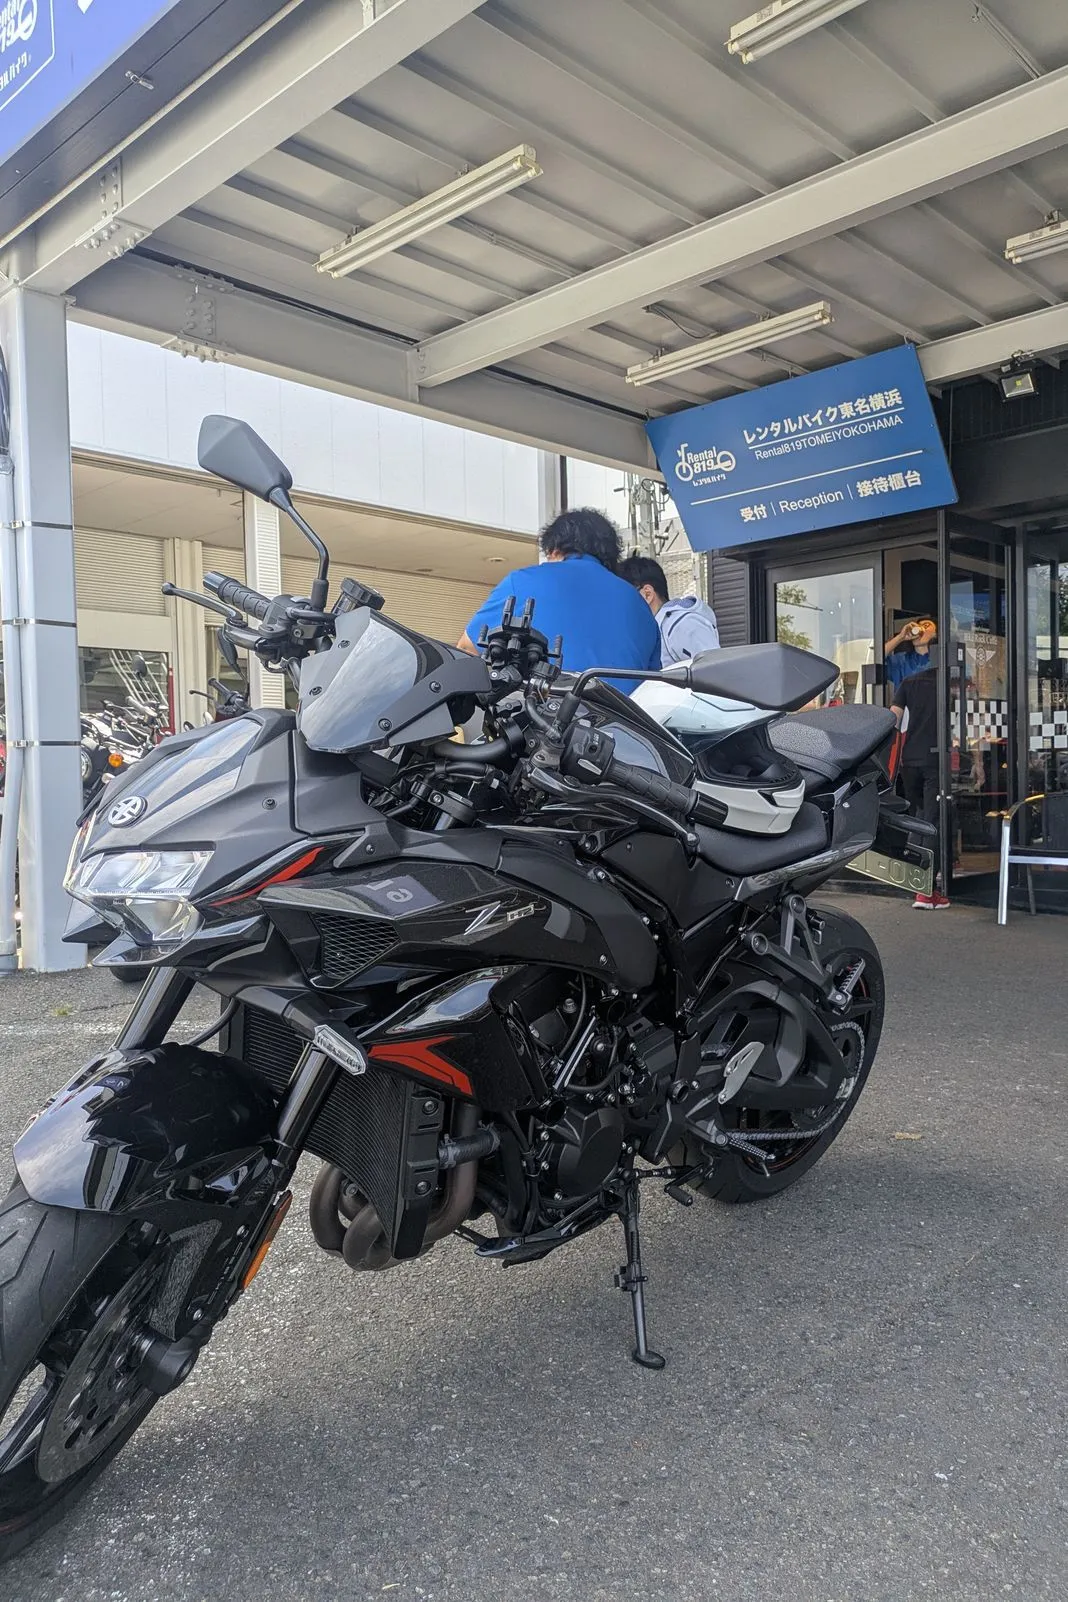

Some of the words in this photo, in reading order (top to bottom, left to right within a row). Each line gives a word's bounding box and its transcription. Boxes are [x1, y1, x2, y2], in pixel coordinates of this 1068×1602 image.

[743, 388, 903, 444] レンタルバイク東名横浜
[755, 414, 903, 460] Rental819TOMEIYOKOHAMA
[686, 446, 717, 464] Rental
[693, 458, 715, 474] 819
[740, 503, 768, 523] 受付
[779, 489, 844, 514] Reception
[856, 470, 922, 498] 接待櫃台
